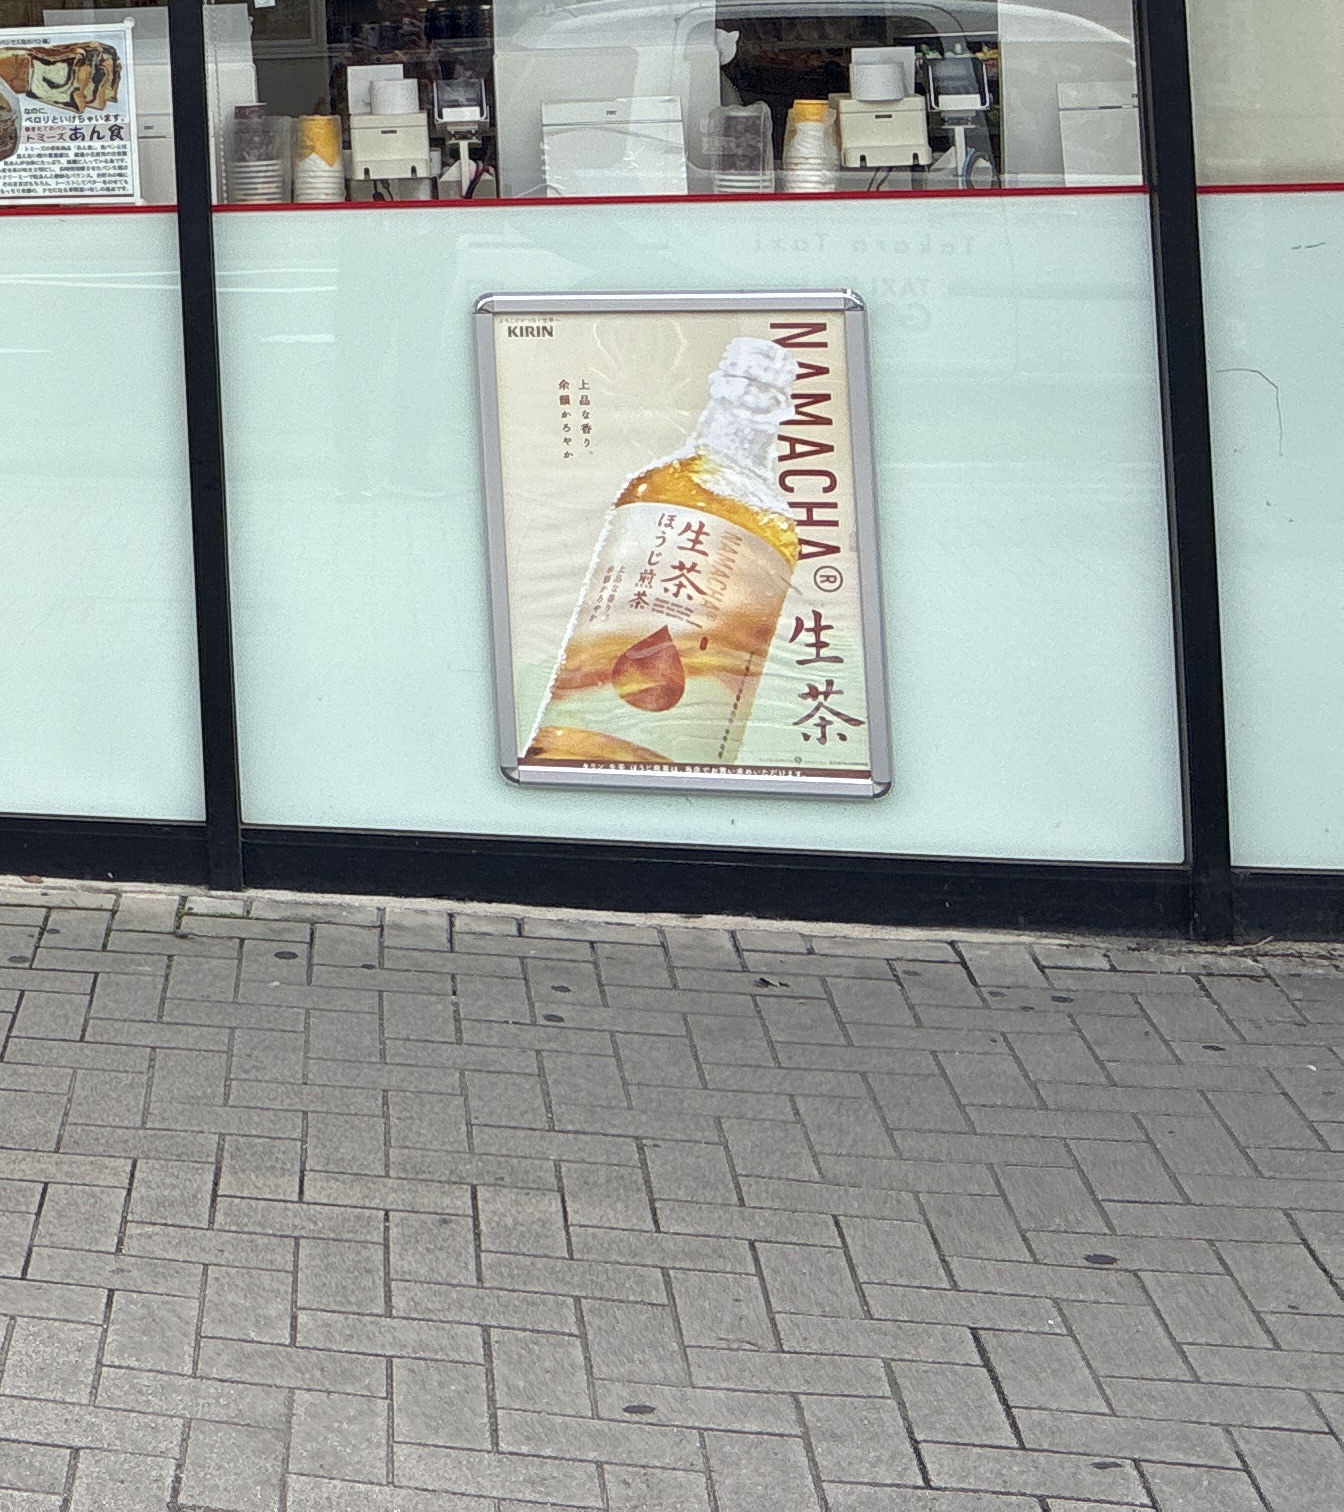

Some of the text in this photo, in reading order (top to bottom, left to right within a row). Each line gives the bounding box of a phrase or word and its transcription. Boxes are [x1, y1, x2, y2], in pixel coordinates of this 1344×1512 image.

[507, 326, 554, 338] KIRIN
[628, 513, 677, 610] ほうじ煎茶
[661, 520, 711, 600] 生茶
[789, 609, 865, 746] 生茶
